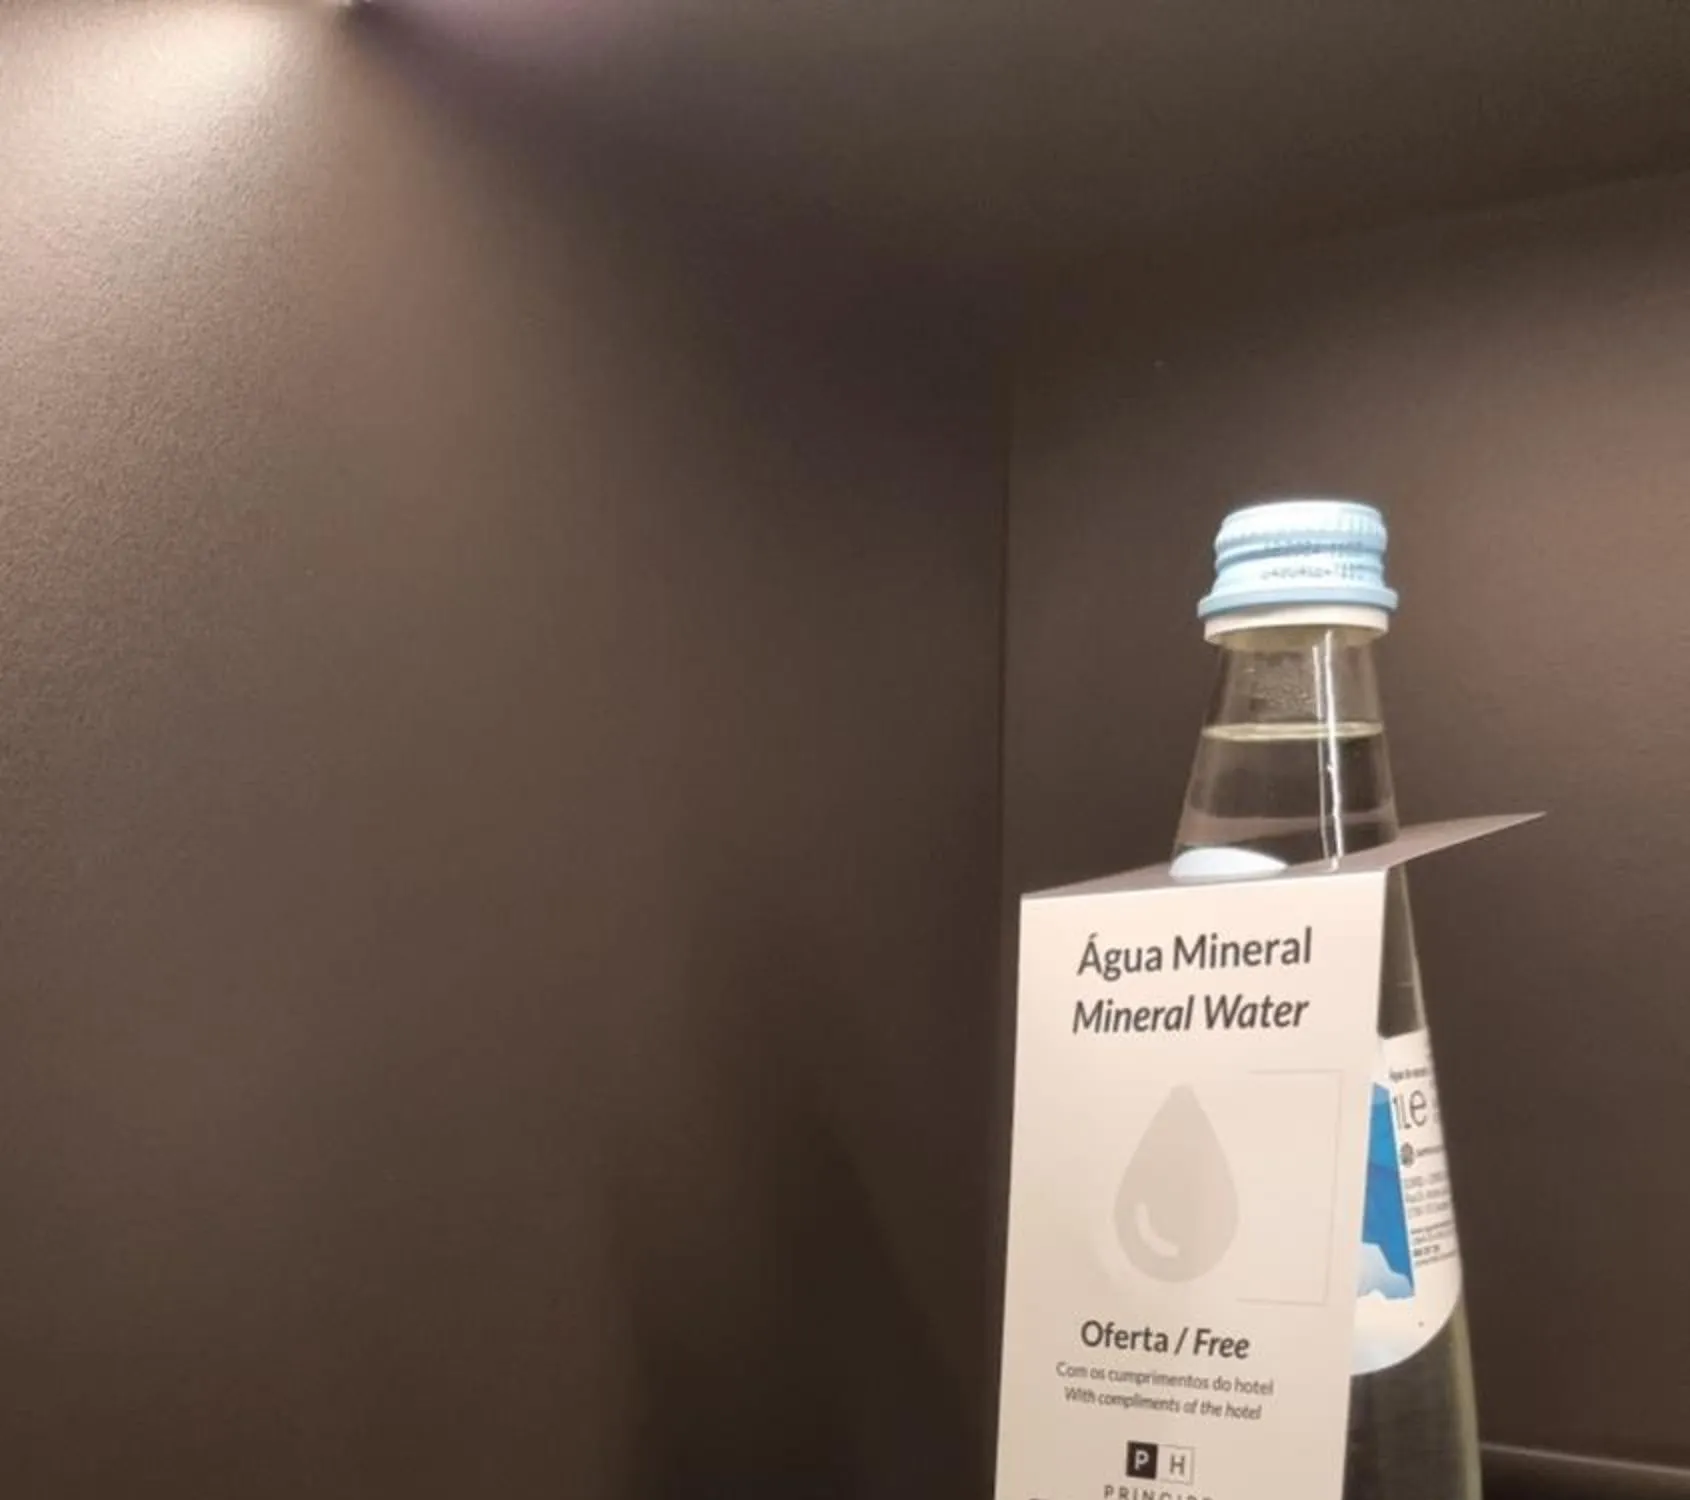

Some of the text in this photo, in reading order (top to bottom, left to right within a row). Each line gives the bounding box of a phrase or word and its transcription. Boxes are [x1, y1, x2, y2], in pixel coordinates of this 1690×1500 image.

[1076, 925, 1312, 982] Água Mineral
[1072, 994, 1310, 1034] Mineral Water
[1080, 1319, 1250, 1360] Oferta / Free
[1055, 1361, 1274, 1396] Com os cumprimentos do hotel
[1063, 1386, 1262, 1420] With compliments of the hotel
